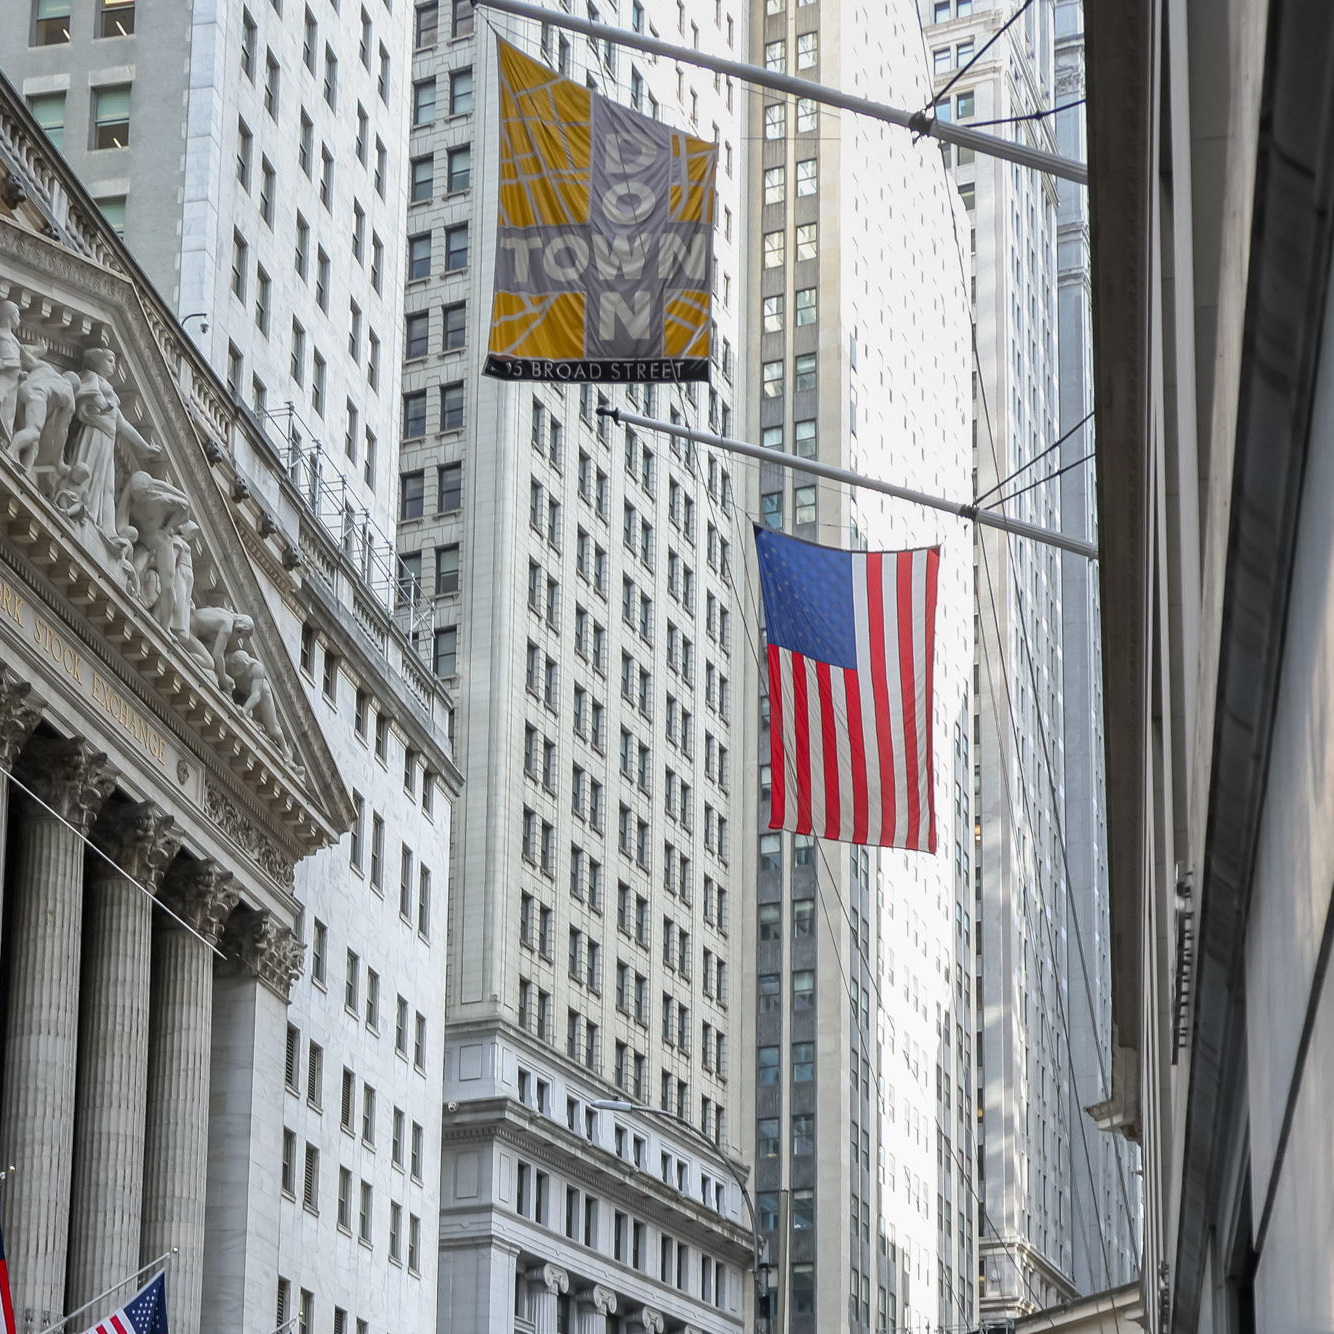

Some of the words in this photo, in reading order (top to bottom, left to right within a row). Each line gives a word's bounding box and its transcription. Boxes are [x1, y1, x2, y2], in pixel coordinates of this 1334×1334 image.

[500, 232, 706, 283] TOWN
[532, 361, 602, 379] BROAD
[611, 361, 685, 380] STREET
[33, 619, 83, 686] STOCK
[91, 673, 167, 767] EXCHANGE
